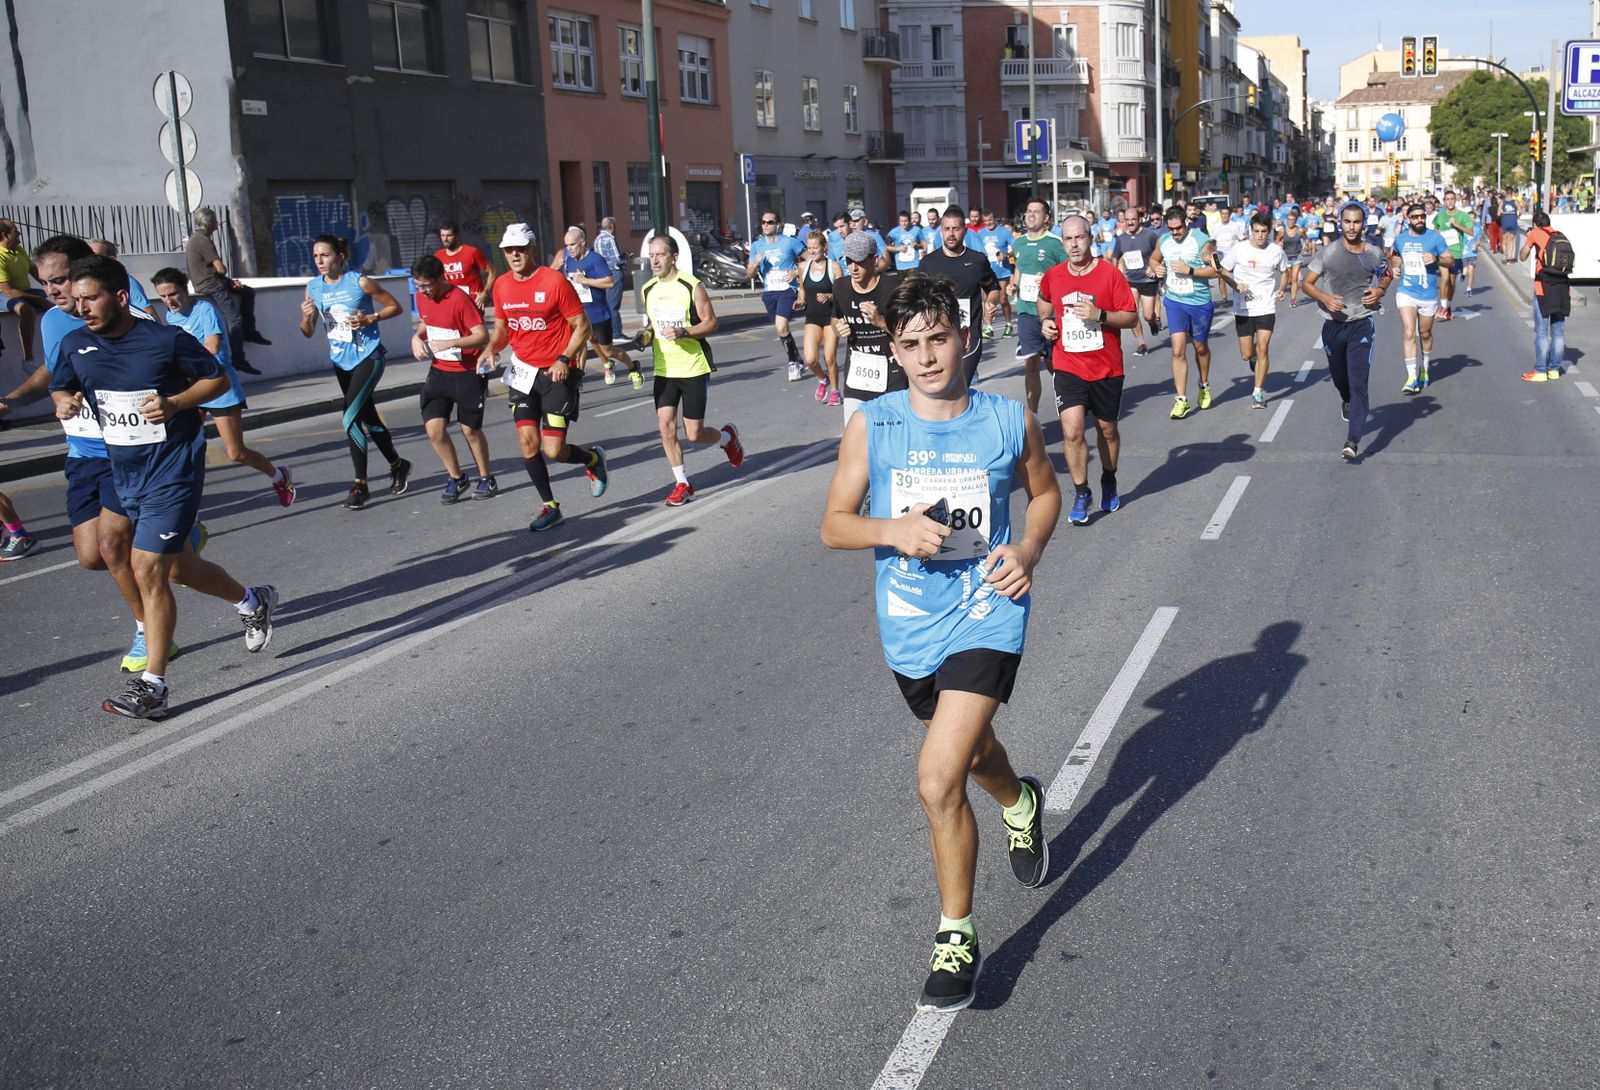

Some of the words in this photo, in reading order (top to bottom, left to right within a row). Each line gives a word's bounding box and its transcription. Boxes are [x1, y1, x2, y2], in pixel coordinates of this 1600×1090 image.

[1021, 123, 1042, 151] P
[1066, 328, 1099, 341] 15051
[855, 366, 881, 379] 8509
[907, 449, 936, 466] 39º
[895, 472, 920, 488] 39º
